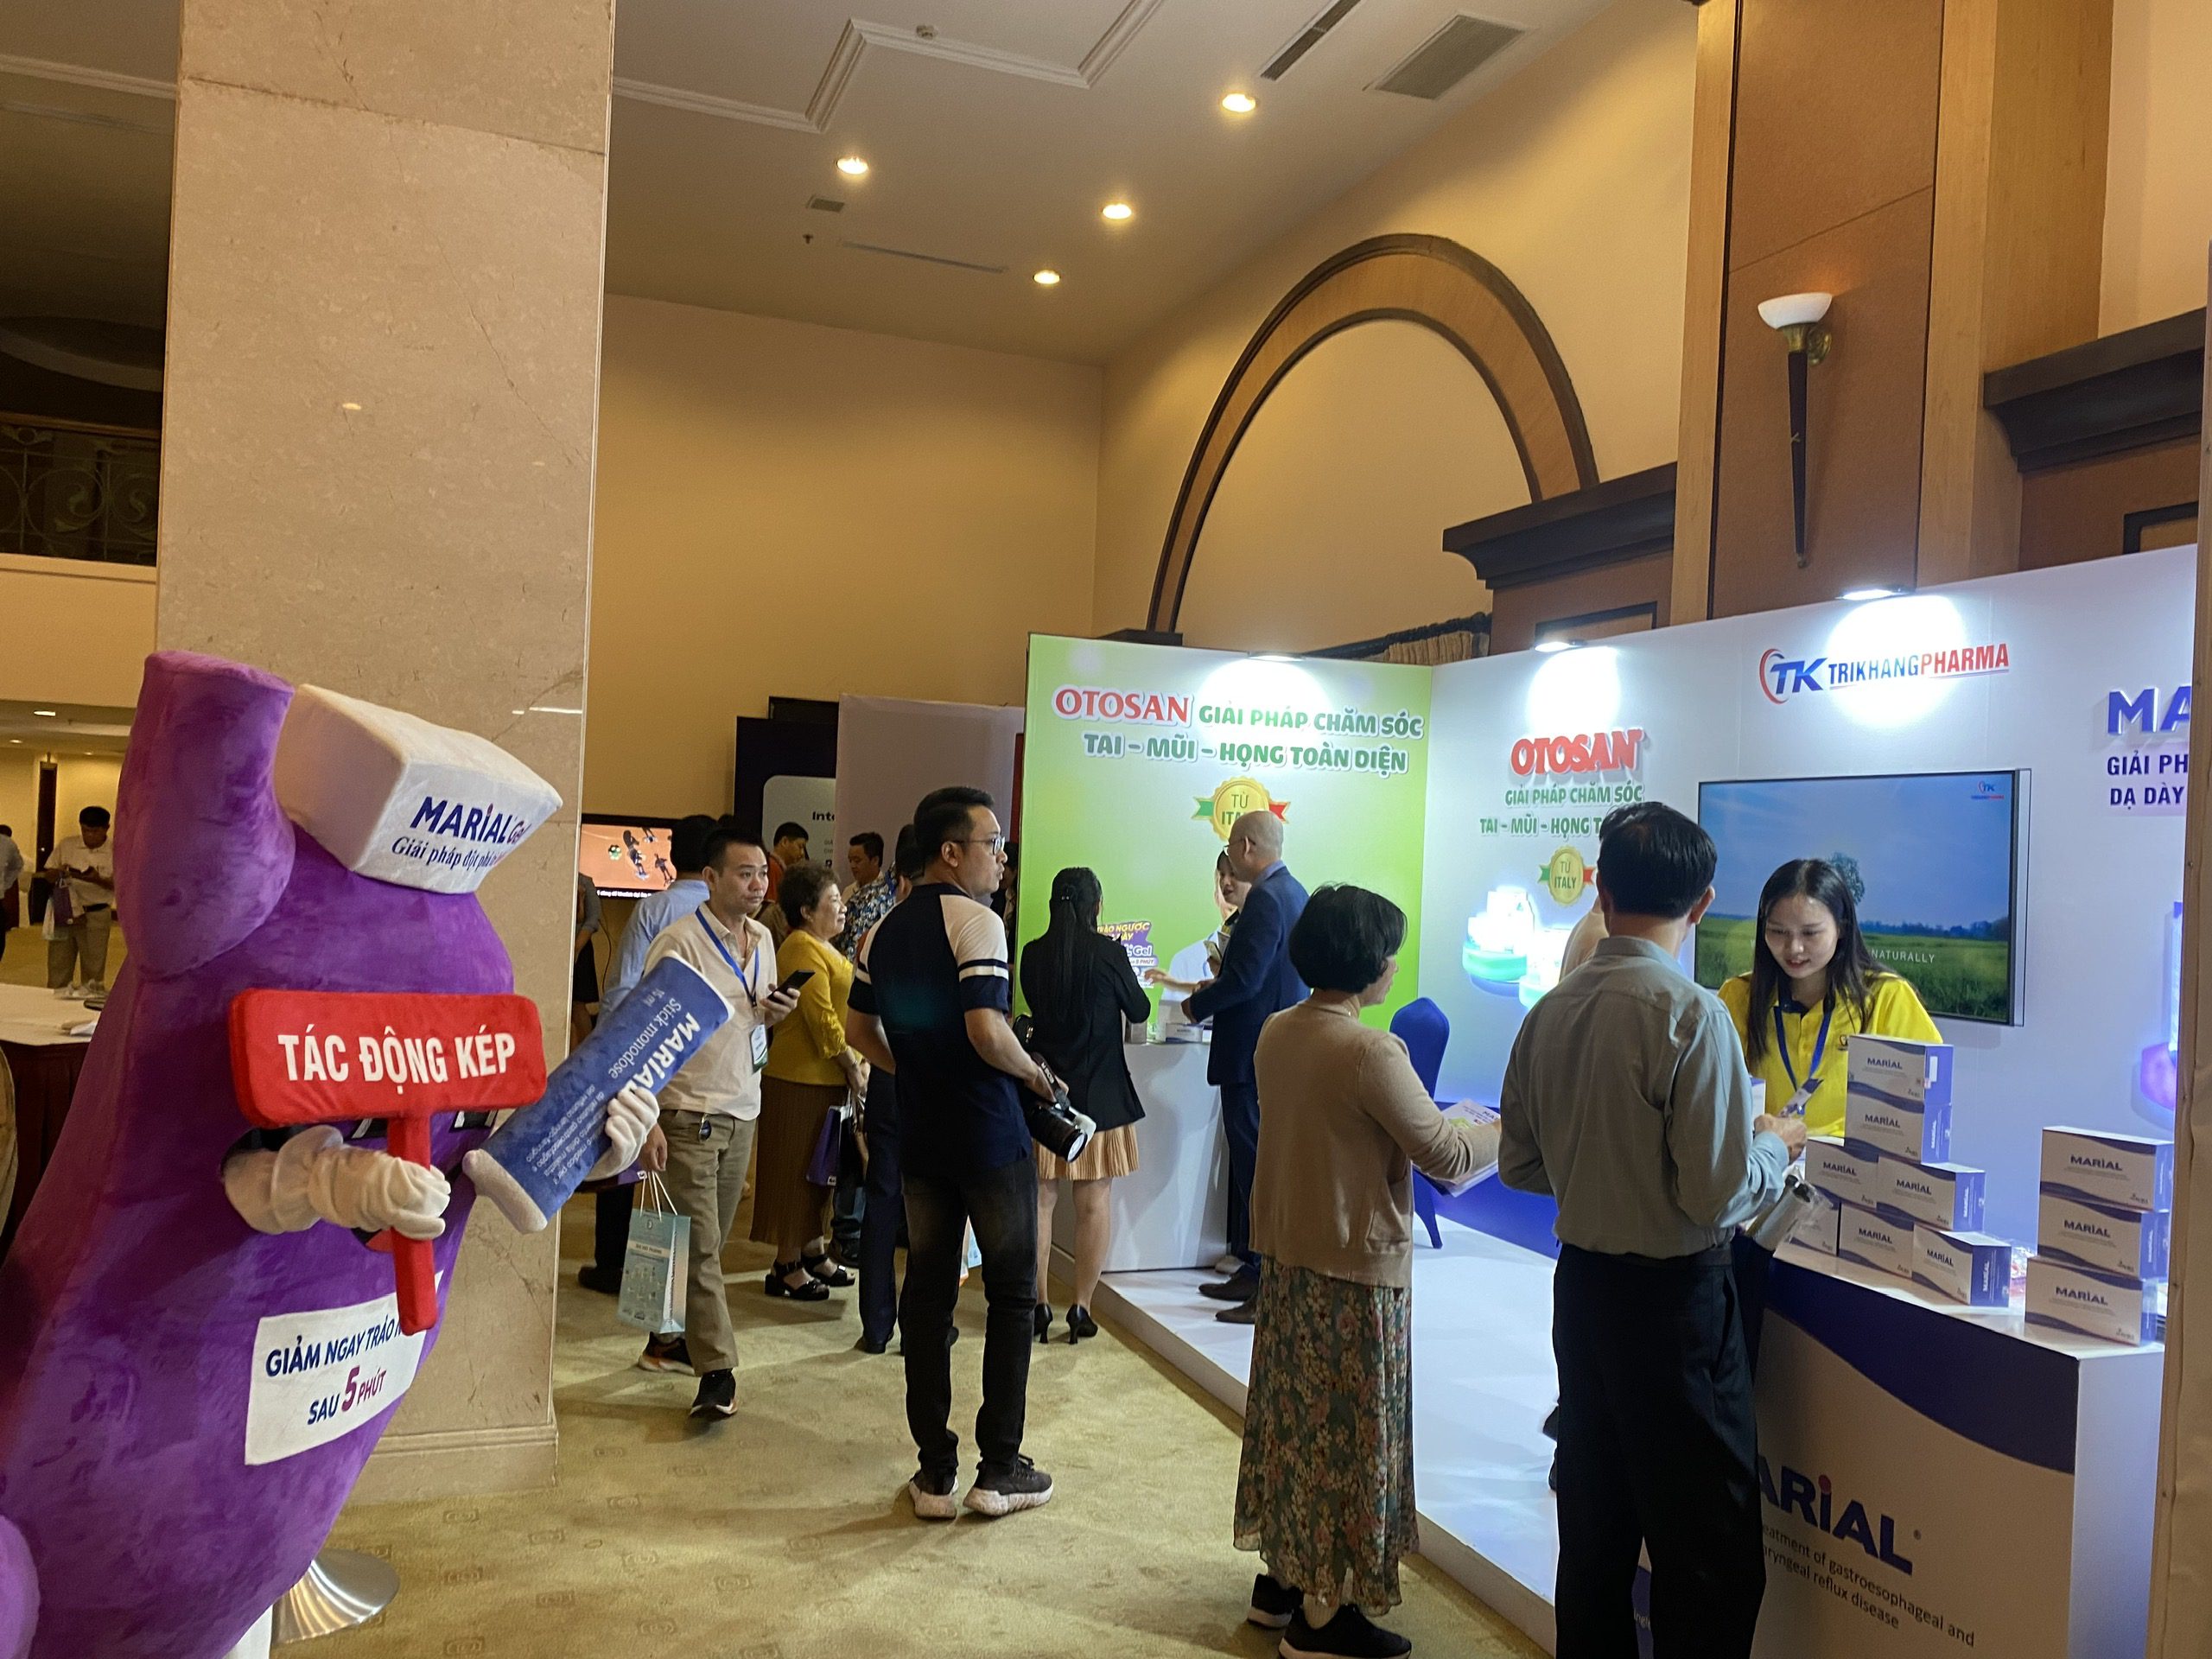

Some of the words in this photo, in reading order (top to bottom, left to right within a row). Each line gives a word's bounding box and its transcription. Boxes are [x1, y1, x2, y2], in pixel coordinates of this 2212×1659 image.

[1770, 657, 1828, 695] TK
[1828, 643, 2009, 685] TRIKHANGPHARMA
[1055, 688, 1189, 724] OTOSAN
[1250, 705, 1308, 729] PHÁP
[1313, 708, 1376, 734] CHĂM
[1382, 711, 1423, 736] SÓC
[1084, 734, 1122, 754] TAI
[1147, 734, 1195, 759] MŨI
[1219, 742, 1284, 767] HỌNG
[1290, 741, 1349, 767] TOÀN
[1355, 746, 1406, 776] DIỆN
[1511, 728, 1643, 775] OTOSAN
[2107, 749, 2150, 776] GIẢI
[2159, 753, 2189, 774] PH
[1505, 784, 1529, 806] GIẢI
[1533, 784, 1567, 804] PHÁP
[1570, 781, 1611, 804] CHĂM
[1614, 779, 1643, 803] SÓC
[2110, 787, 2136, 810] DẠ
[2144, 781, 2184, 805] DÀY
[1480, 818, 1497, 834] TAI
[1512, 813, 1537, 834] MŨI
[1551, 817, 1590, 838] HỌNG
[391, 836, 429, 860] Giải
[426, 846, 463, 872] pháp
[1554, 876, 1577, 889] ITALY
[1872, 948, 1935, 963] NATURALLY
[657, 997, 682, 1028] Stick
[277, 1023, 349, 1082] TÁC
[359, 1025, 448, 1095] ĐỘNG
[454, 1024, 516, 1079] KÉP
[607, 1022, 658, 1079] monodose
[265, 1334, 321, 1377] GIẢM
[324, 1330, 366, 1366] NGAY
[307, 1393, 340, 1426] SAU
[341, 1364, 360, 1412] 5
[357, 1367, 387, 1407] PHÚT
[1764, 1524, 1810, 1558] eatment
[1814, 1549, 1827, 1566] of
[1828, 1560, 1944, 1630] gastroesophageal
[1948, 1622, 1974, 1648] and
[1814, 1568, 1848, 1600] reflux
[1851, 1592, 1899, 1630] disease
